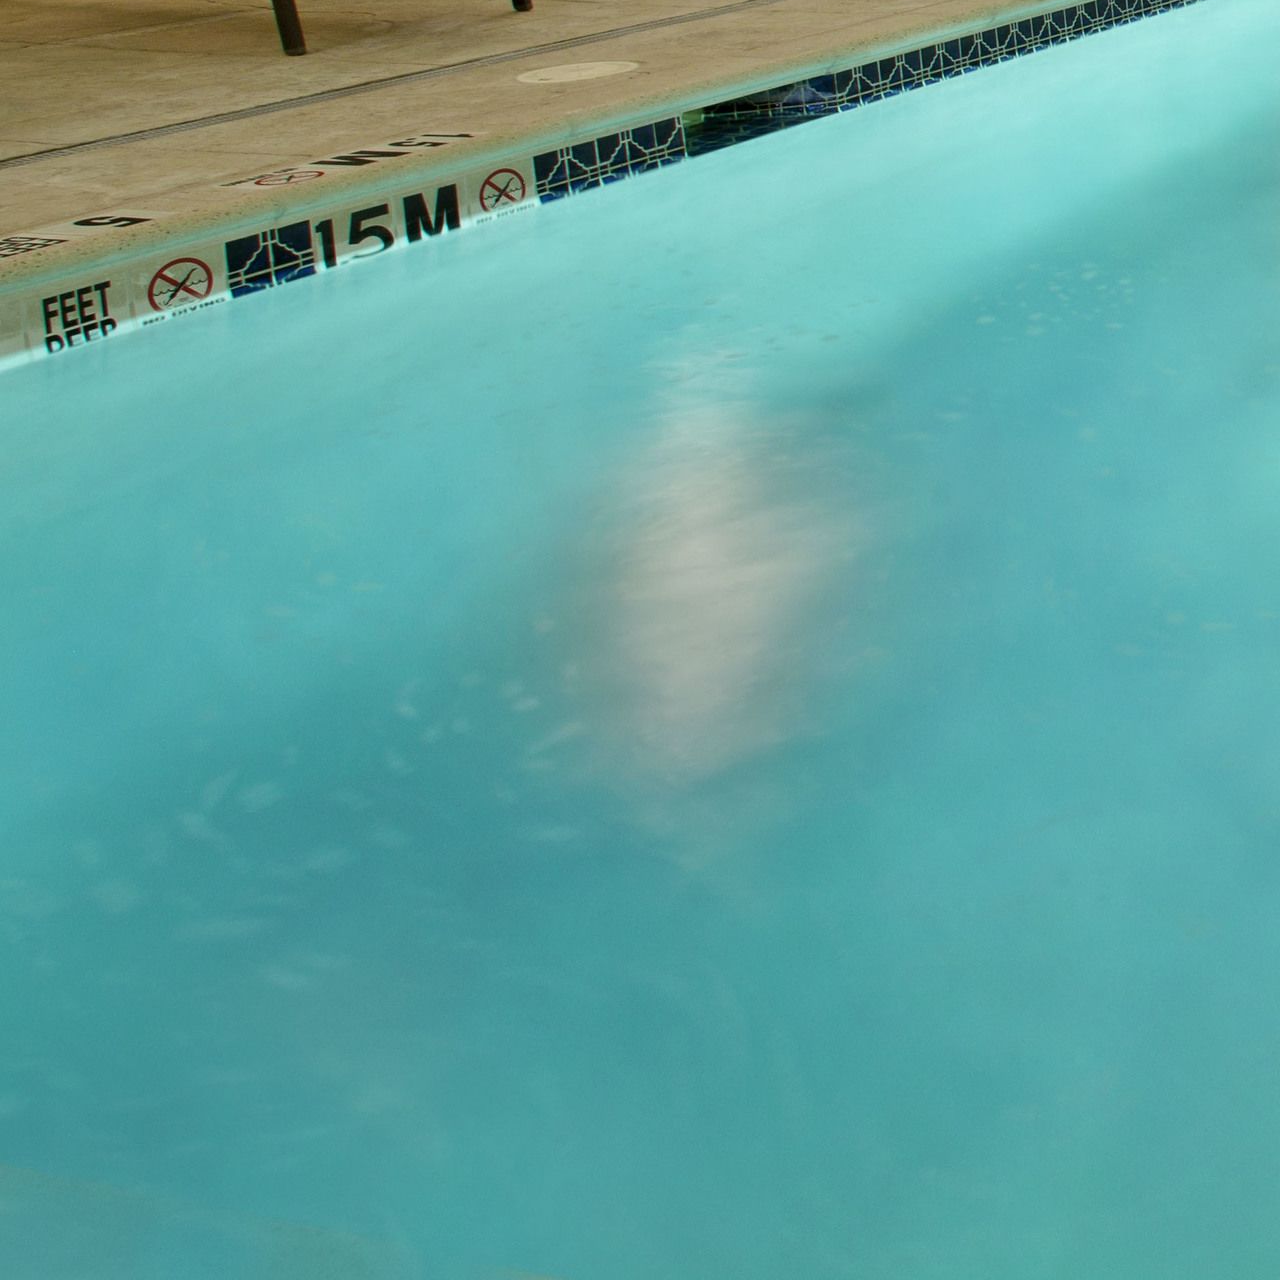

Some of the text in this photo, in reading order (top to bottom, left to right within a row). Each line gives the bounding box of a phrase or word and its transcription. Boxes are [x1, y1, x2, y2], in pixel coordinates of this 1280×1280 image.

[72, 215, 153, 228] 5
[403, 183, 461, 243] M
[42, 280, 111, 334] FEET
